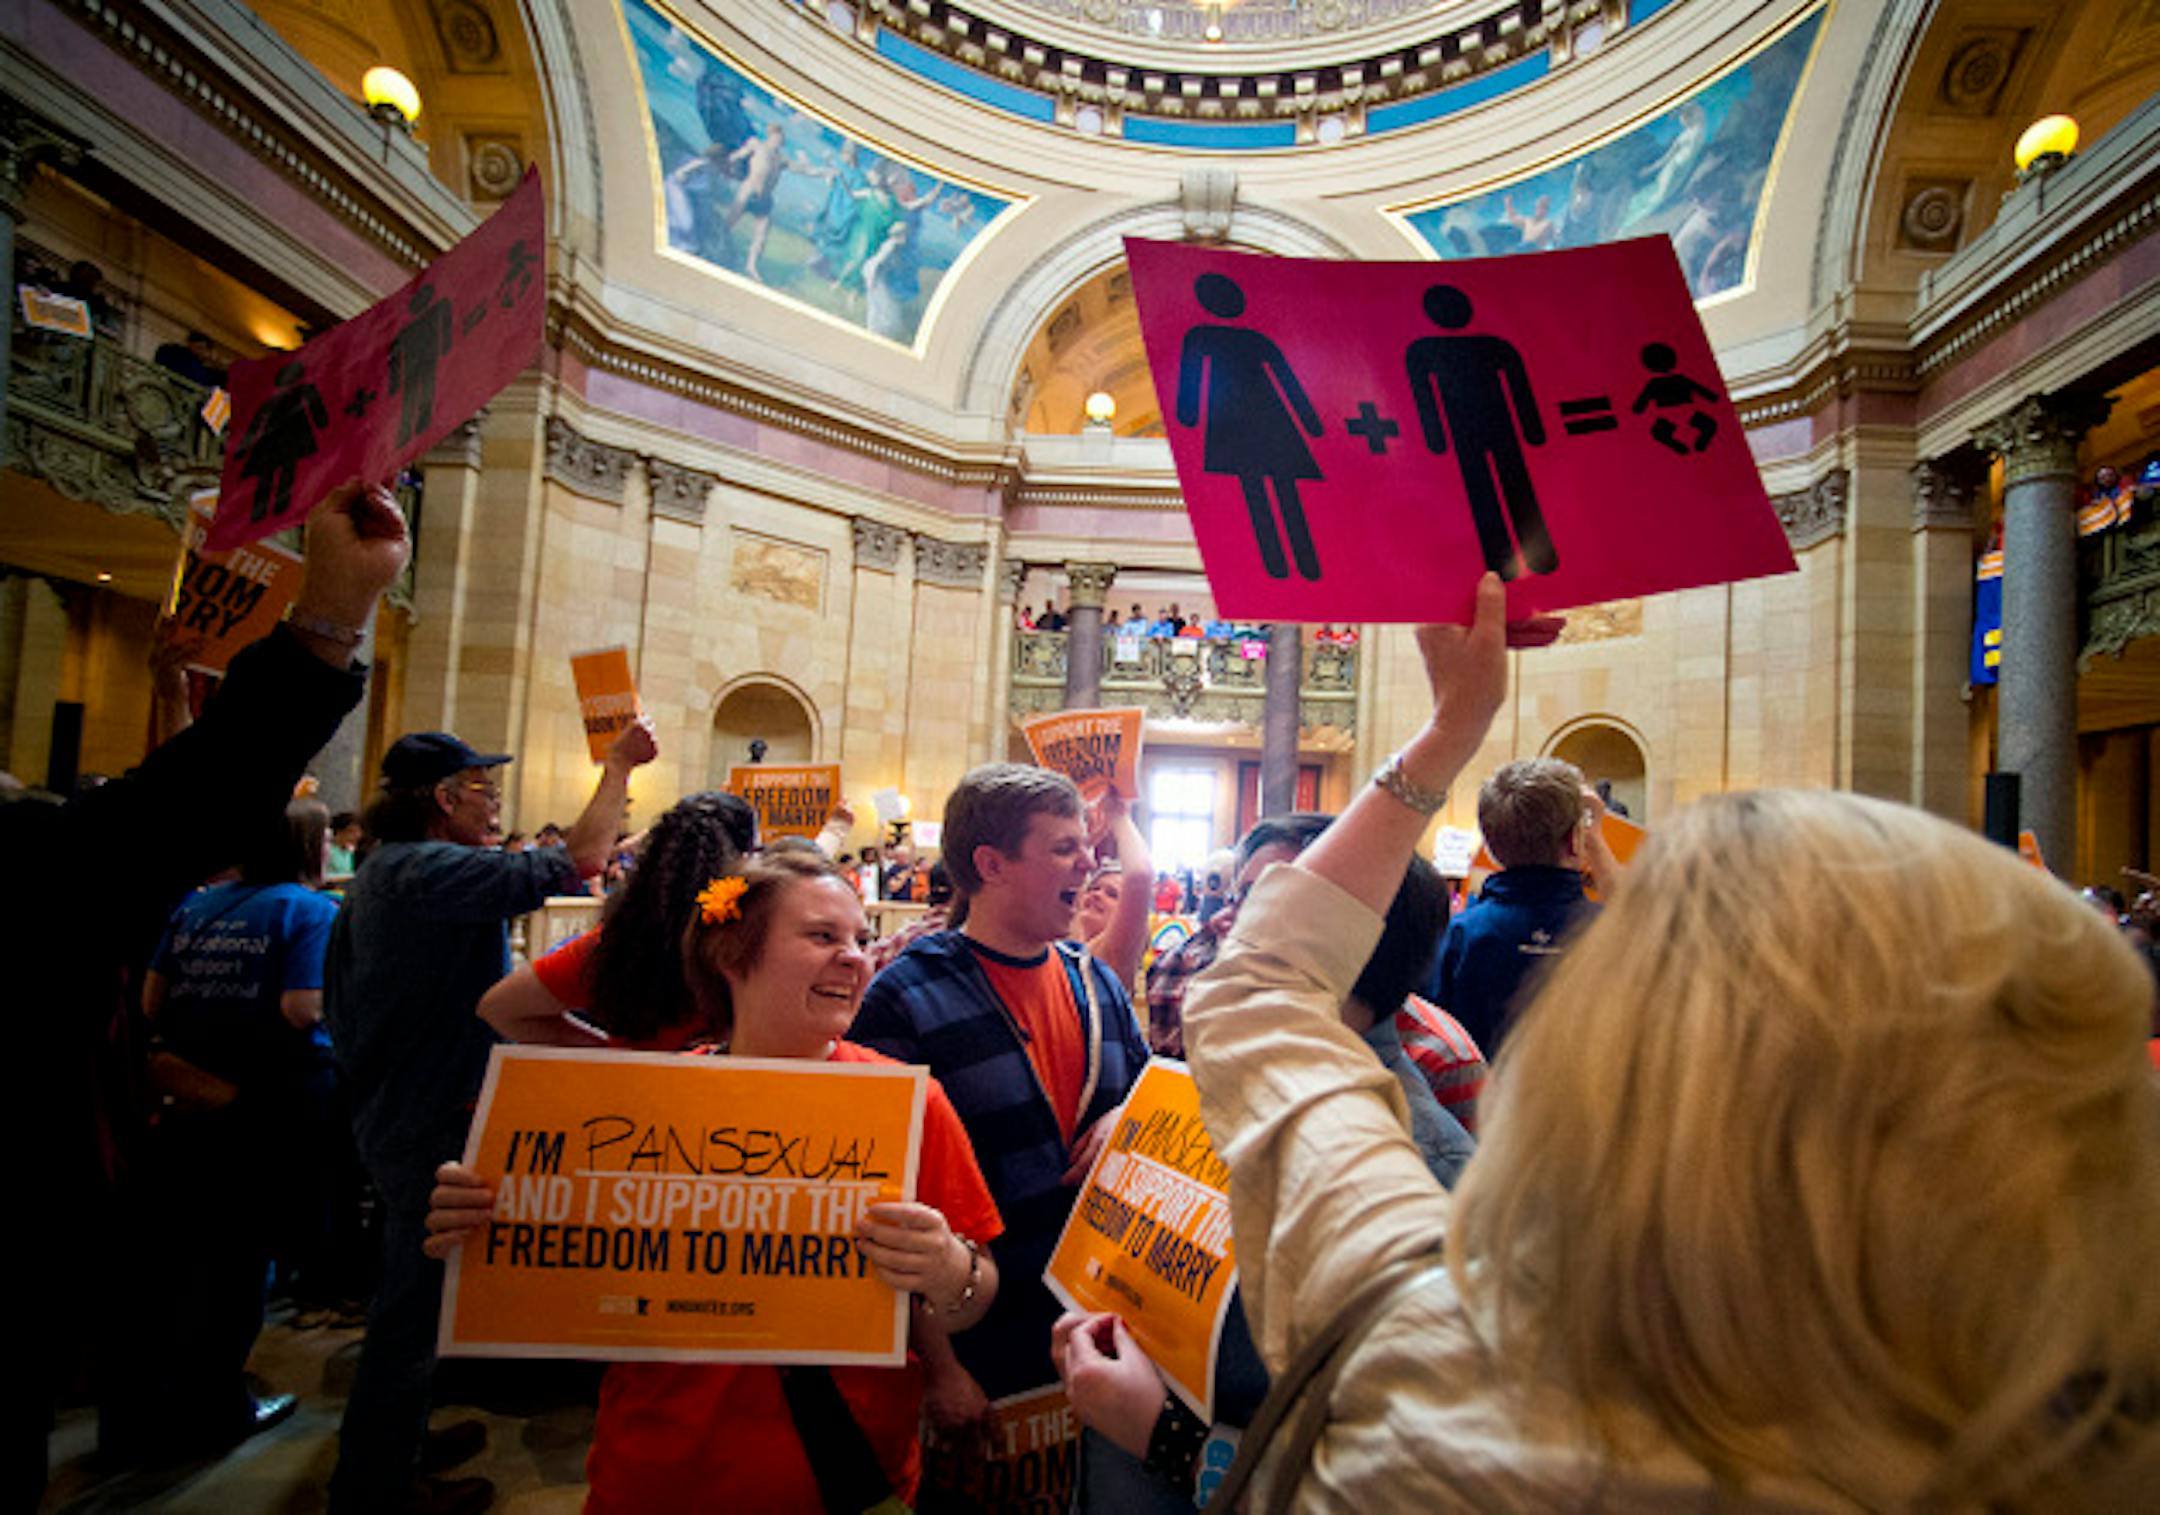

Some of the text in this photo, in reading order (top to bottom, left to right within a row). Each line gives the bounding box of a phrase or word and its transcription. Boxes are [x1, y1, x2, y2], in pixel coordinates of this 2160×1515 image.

[743, 786, 830, 806] FREEDOM
[505, 1115, 889, 1185] I'M PANSEXUAL
[493, 1173, 575, 1223] AND
[584, 1177, 600, 1225] I
[608, 1177, 798, 1233] SUPPORT
[486, 1221, 871, 1280] FREEDOM TO MARRY
[1123, 1213, 1156, 1259] TO
[1145, 1226, 1222, 1304] MARRY
[1025, 1405, 1078, 1451] THE
